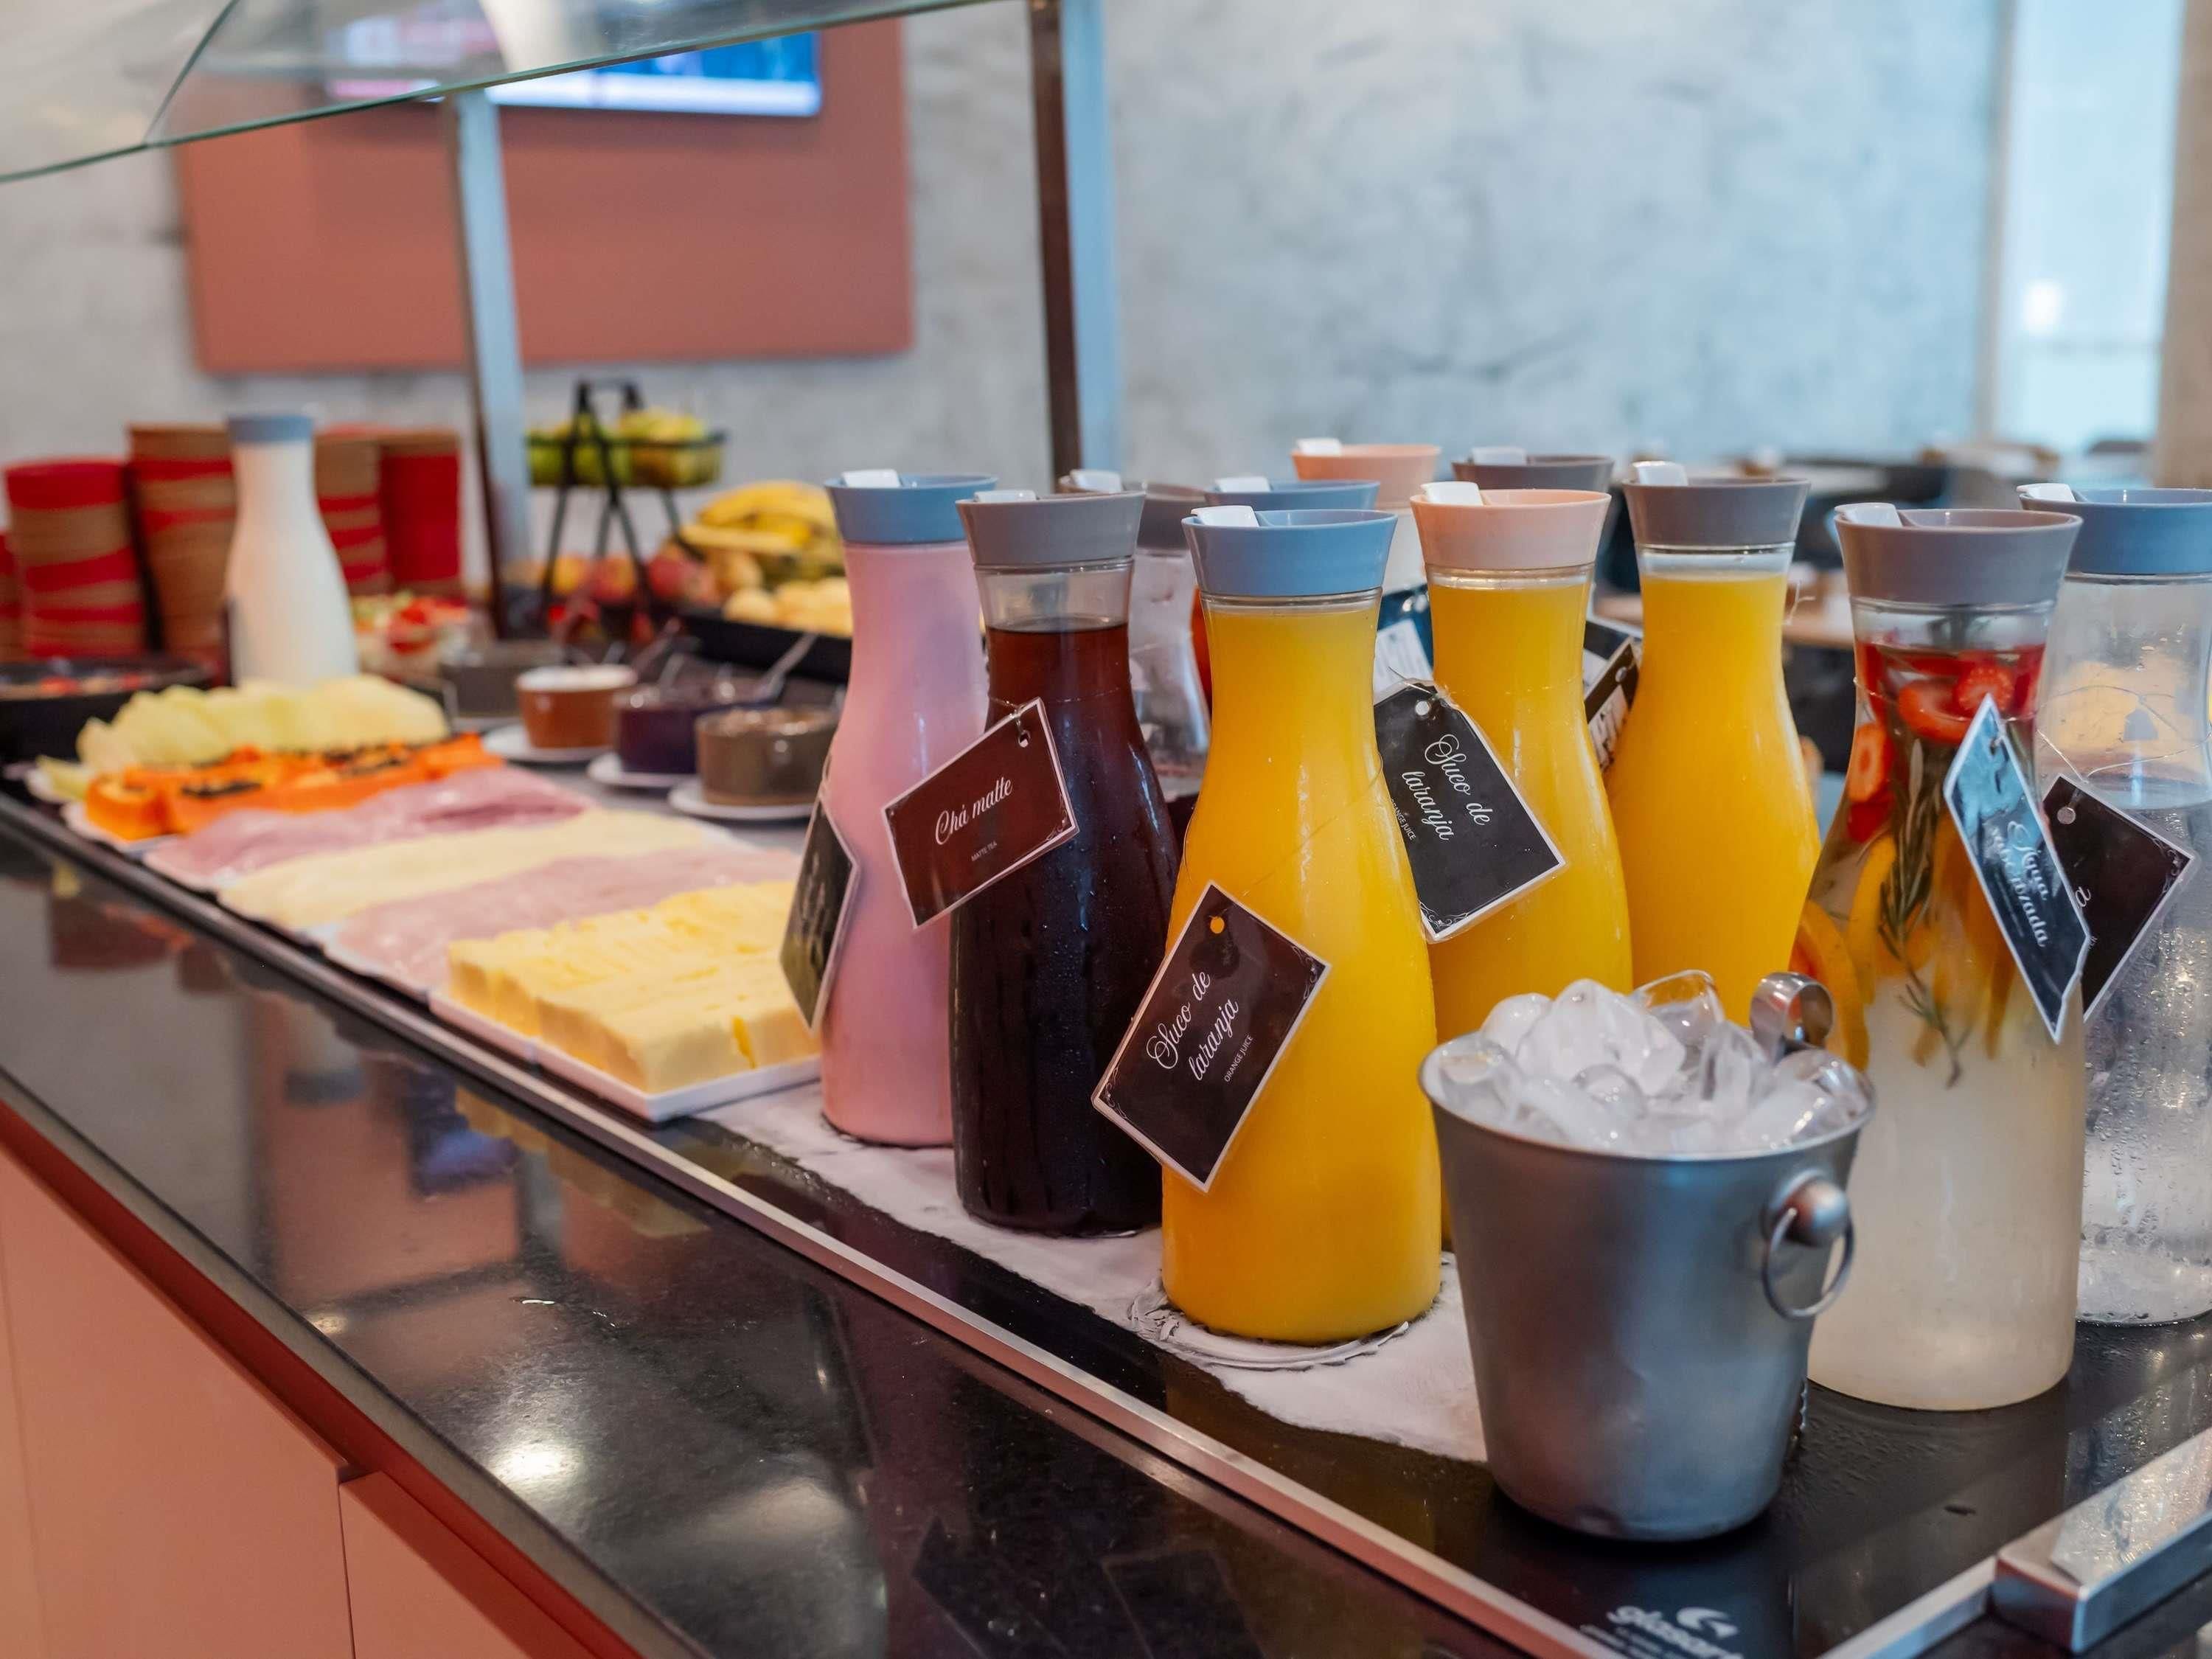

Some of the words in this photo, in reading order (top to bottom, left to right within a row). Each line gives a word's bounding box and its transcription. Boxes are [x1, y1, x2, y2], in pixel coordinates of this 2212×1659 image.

[935, 804, 970, 845] Chá
[972, 776, 1012, 819] matte
[1402, 771, 1455, 841] laranja
[1425, 734, 1472, 796] Suco
[1466, 802, 1494, 826] de
[1400, 822, 1416, 841] JUICE
[1146, 1001, 1192, 1069] Suco
[1192, 971, 1211, 1001] de
[1188, 998, 1239, 1081] laranja
[1224, 1052, 1244, 1082] ORANGE
[1239, 1034, 1253, 1056] JUICE
